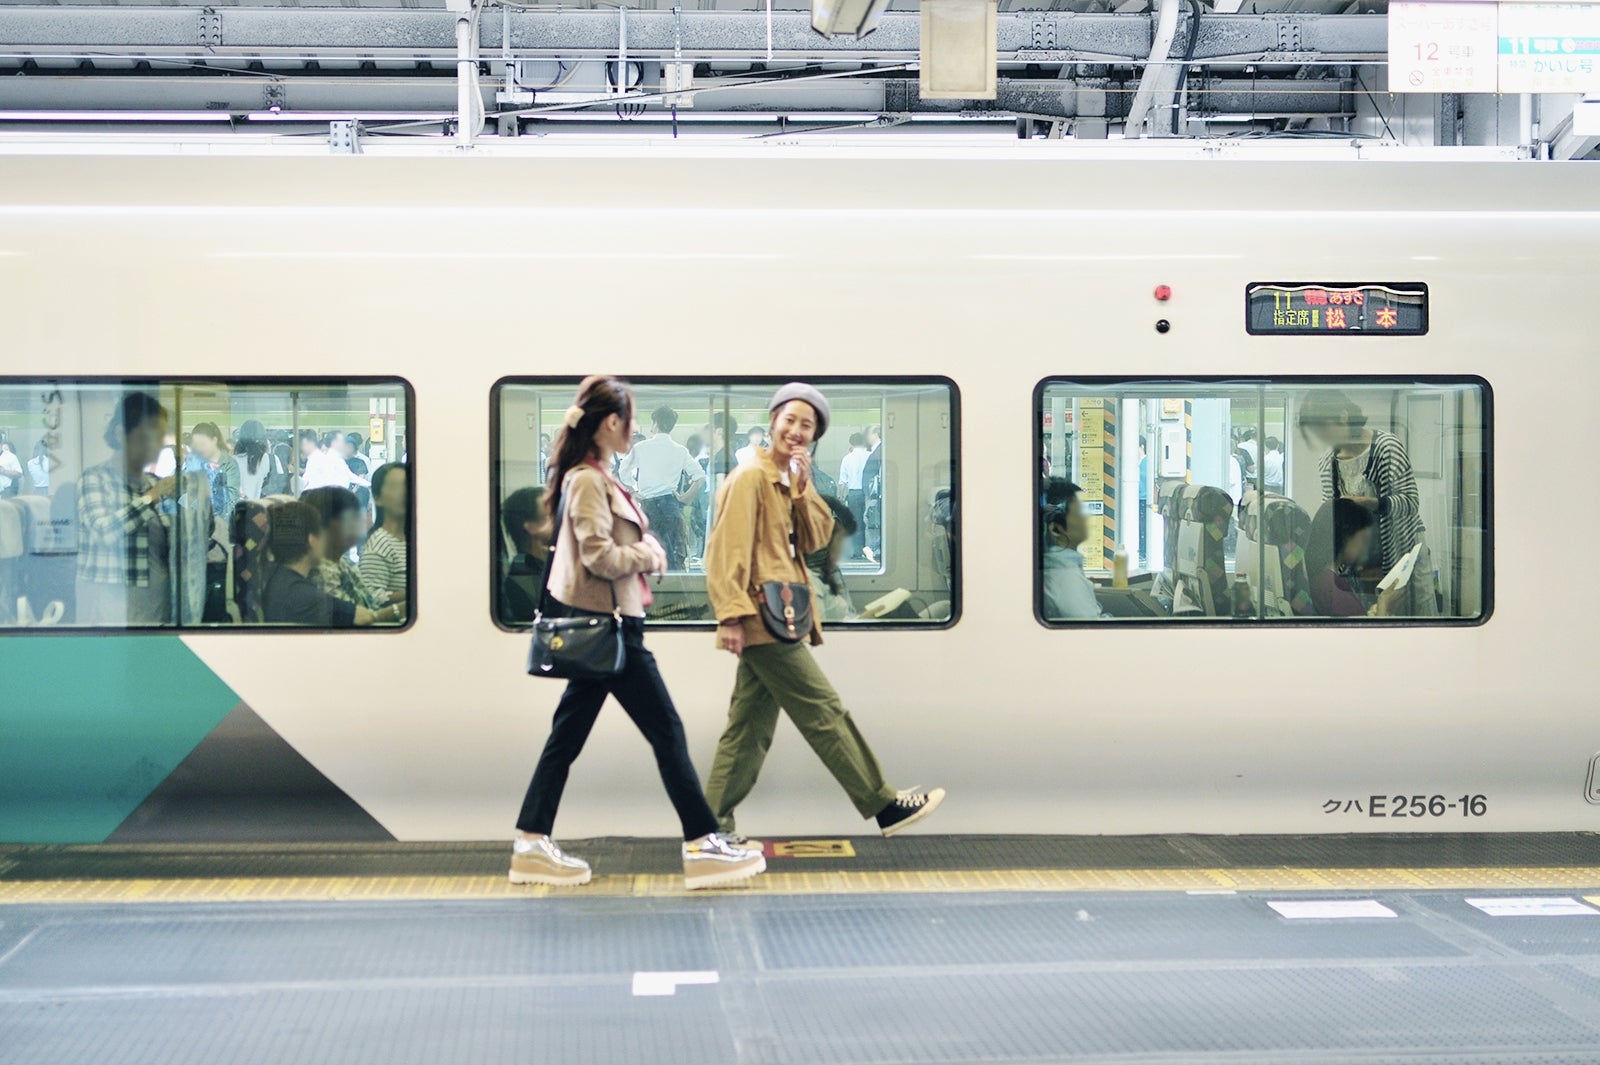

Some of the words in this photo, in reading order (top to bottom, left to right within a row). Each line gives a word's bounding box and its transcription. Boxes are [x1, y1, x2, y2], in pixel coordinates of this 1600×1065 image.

[1413, 42, 1439, 61] 12
[1273, 291, 1291, 309] 11
[1273, 309, 1310, 326] 指定席
